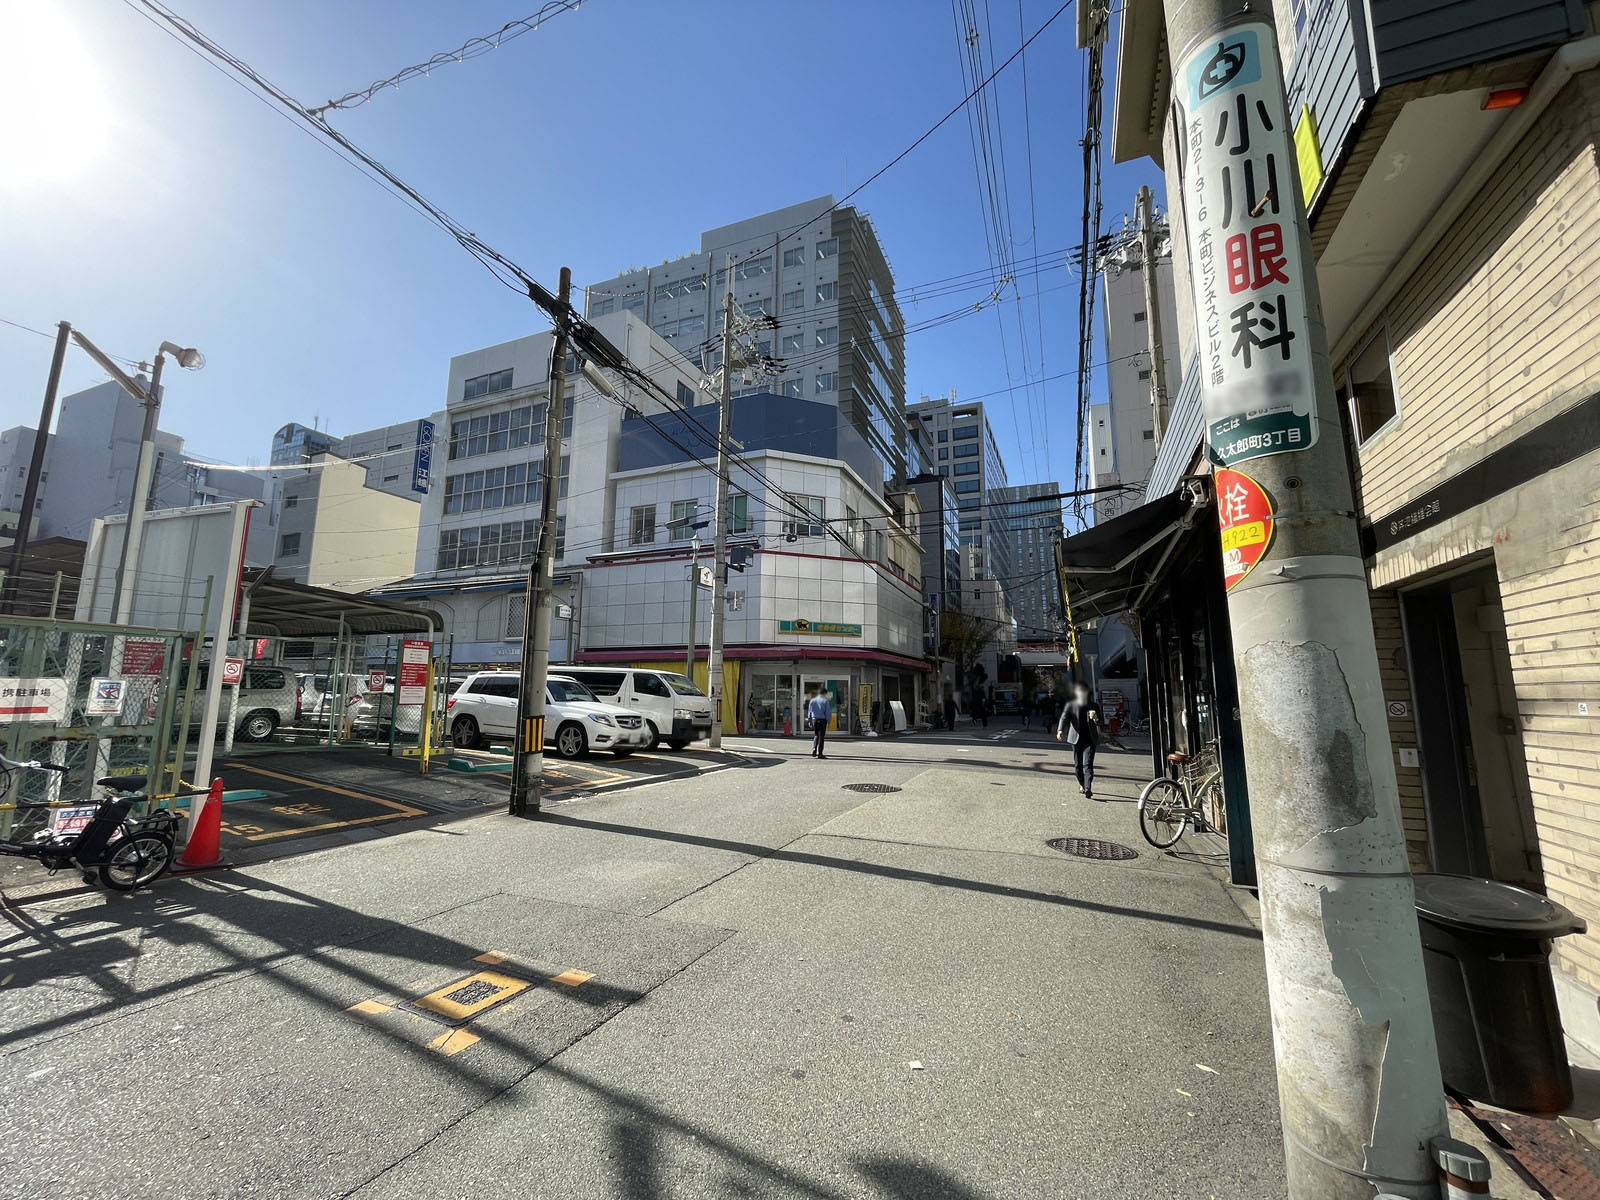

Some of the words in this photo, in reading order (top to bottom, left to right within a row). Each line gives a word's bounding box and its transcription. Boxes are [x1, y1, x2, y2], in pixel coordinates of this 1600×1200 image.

[1215, 93, 1296, 369] 小川眼科
[1215, 417, 1241, 436] ここは
[1216, 428, 1301, 461] 久太郎町3丁目
